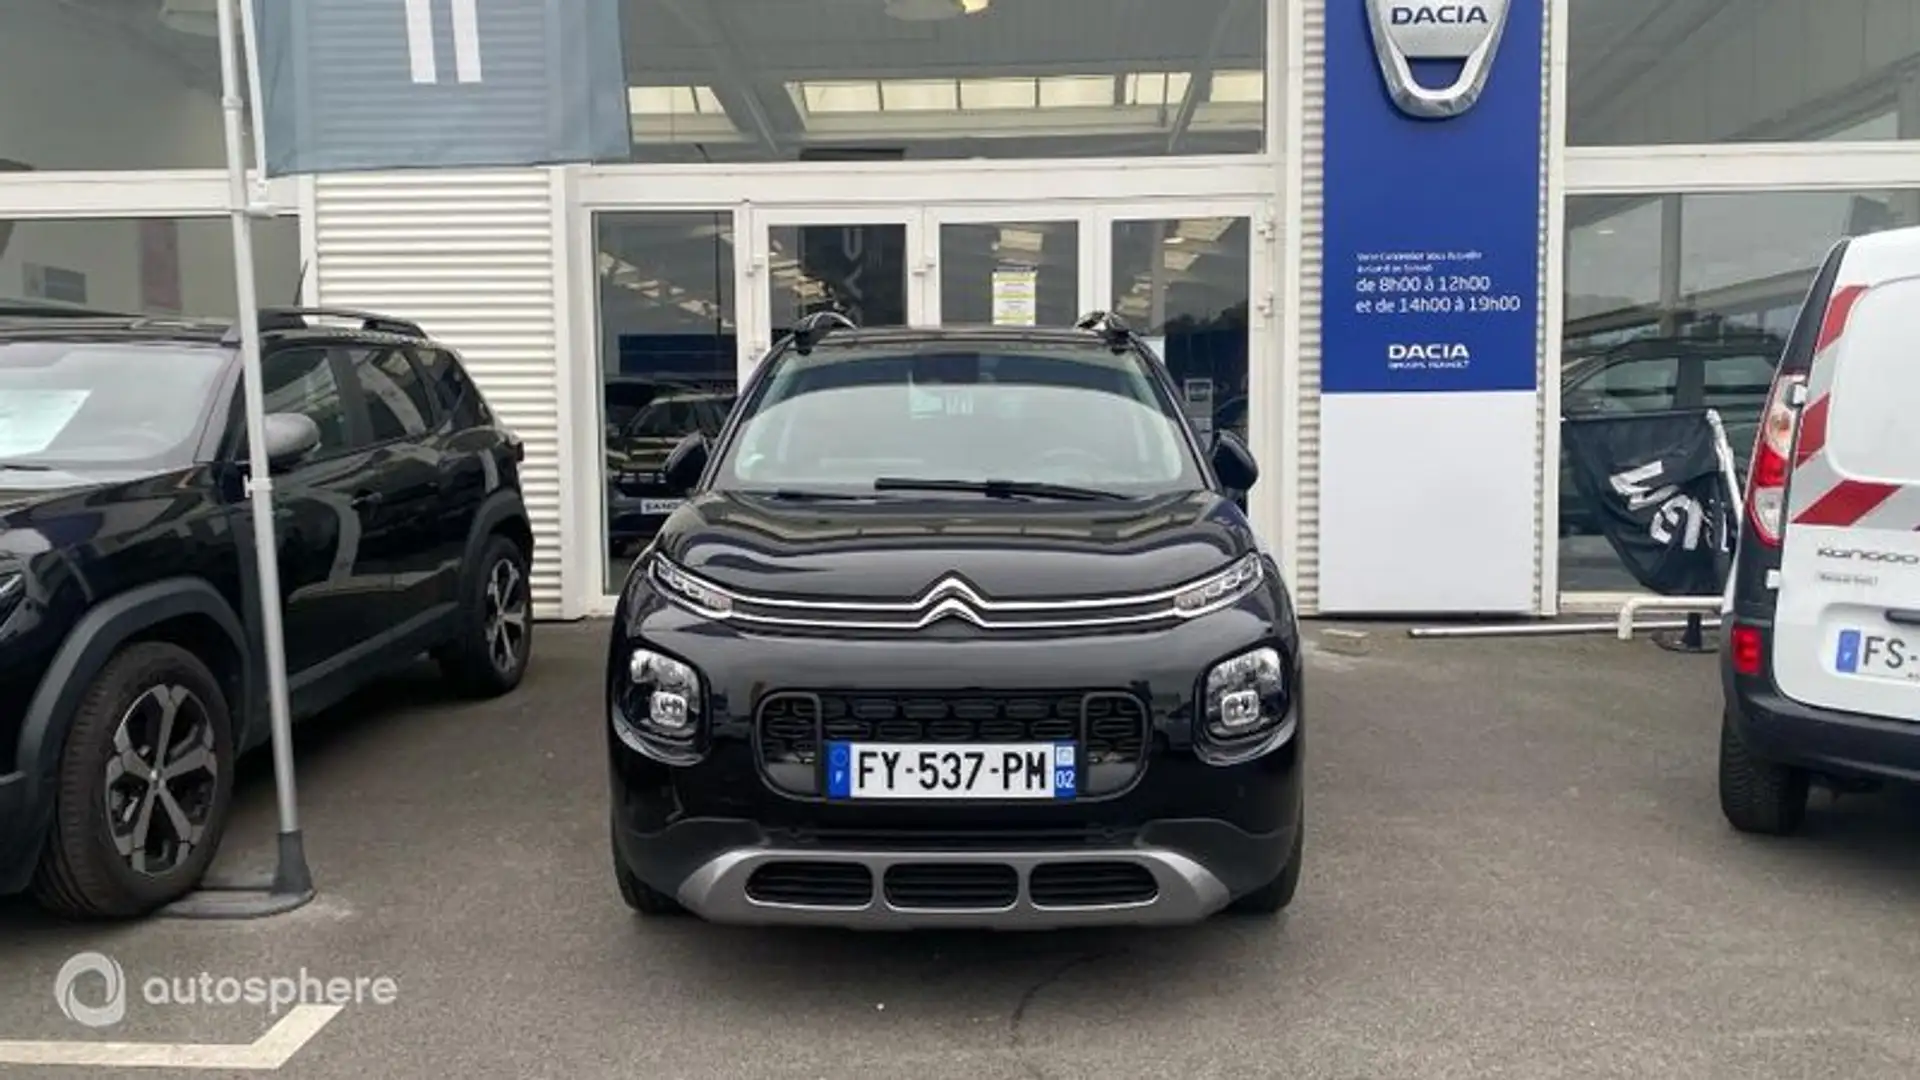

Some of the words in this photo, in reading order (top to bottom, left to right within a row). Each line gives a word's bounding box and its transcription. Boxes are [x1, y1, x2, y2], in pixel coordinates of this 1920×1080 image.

[1391, 6, 1488, 24] DACIA
[1356, 277, 1376, 292] de
[1379, 276, 1422, 292] 8h00
[1424, 276, 1435, 292] à
[1438, 276, 1491, 292] 12h00
[1355, 299, 1372, 313] et
[1375, 298, 1395, 313] de
[1399, 297, 1451, 313] 14h00
[1454, 296, 1465, 312] à
[1469, 295, 1521, 311] 19h00
[1388, 343, 1470, 359] DACIA
[858, 751, 1047, 791] FY-537-PM
[1056, 770, 1075, 789] 02
